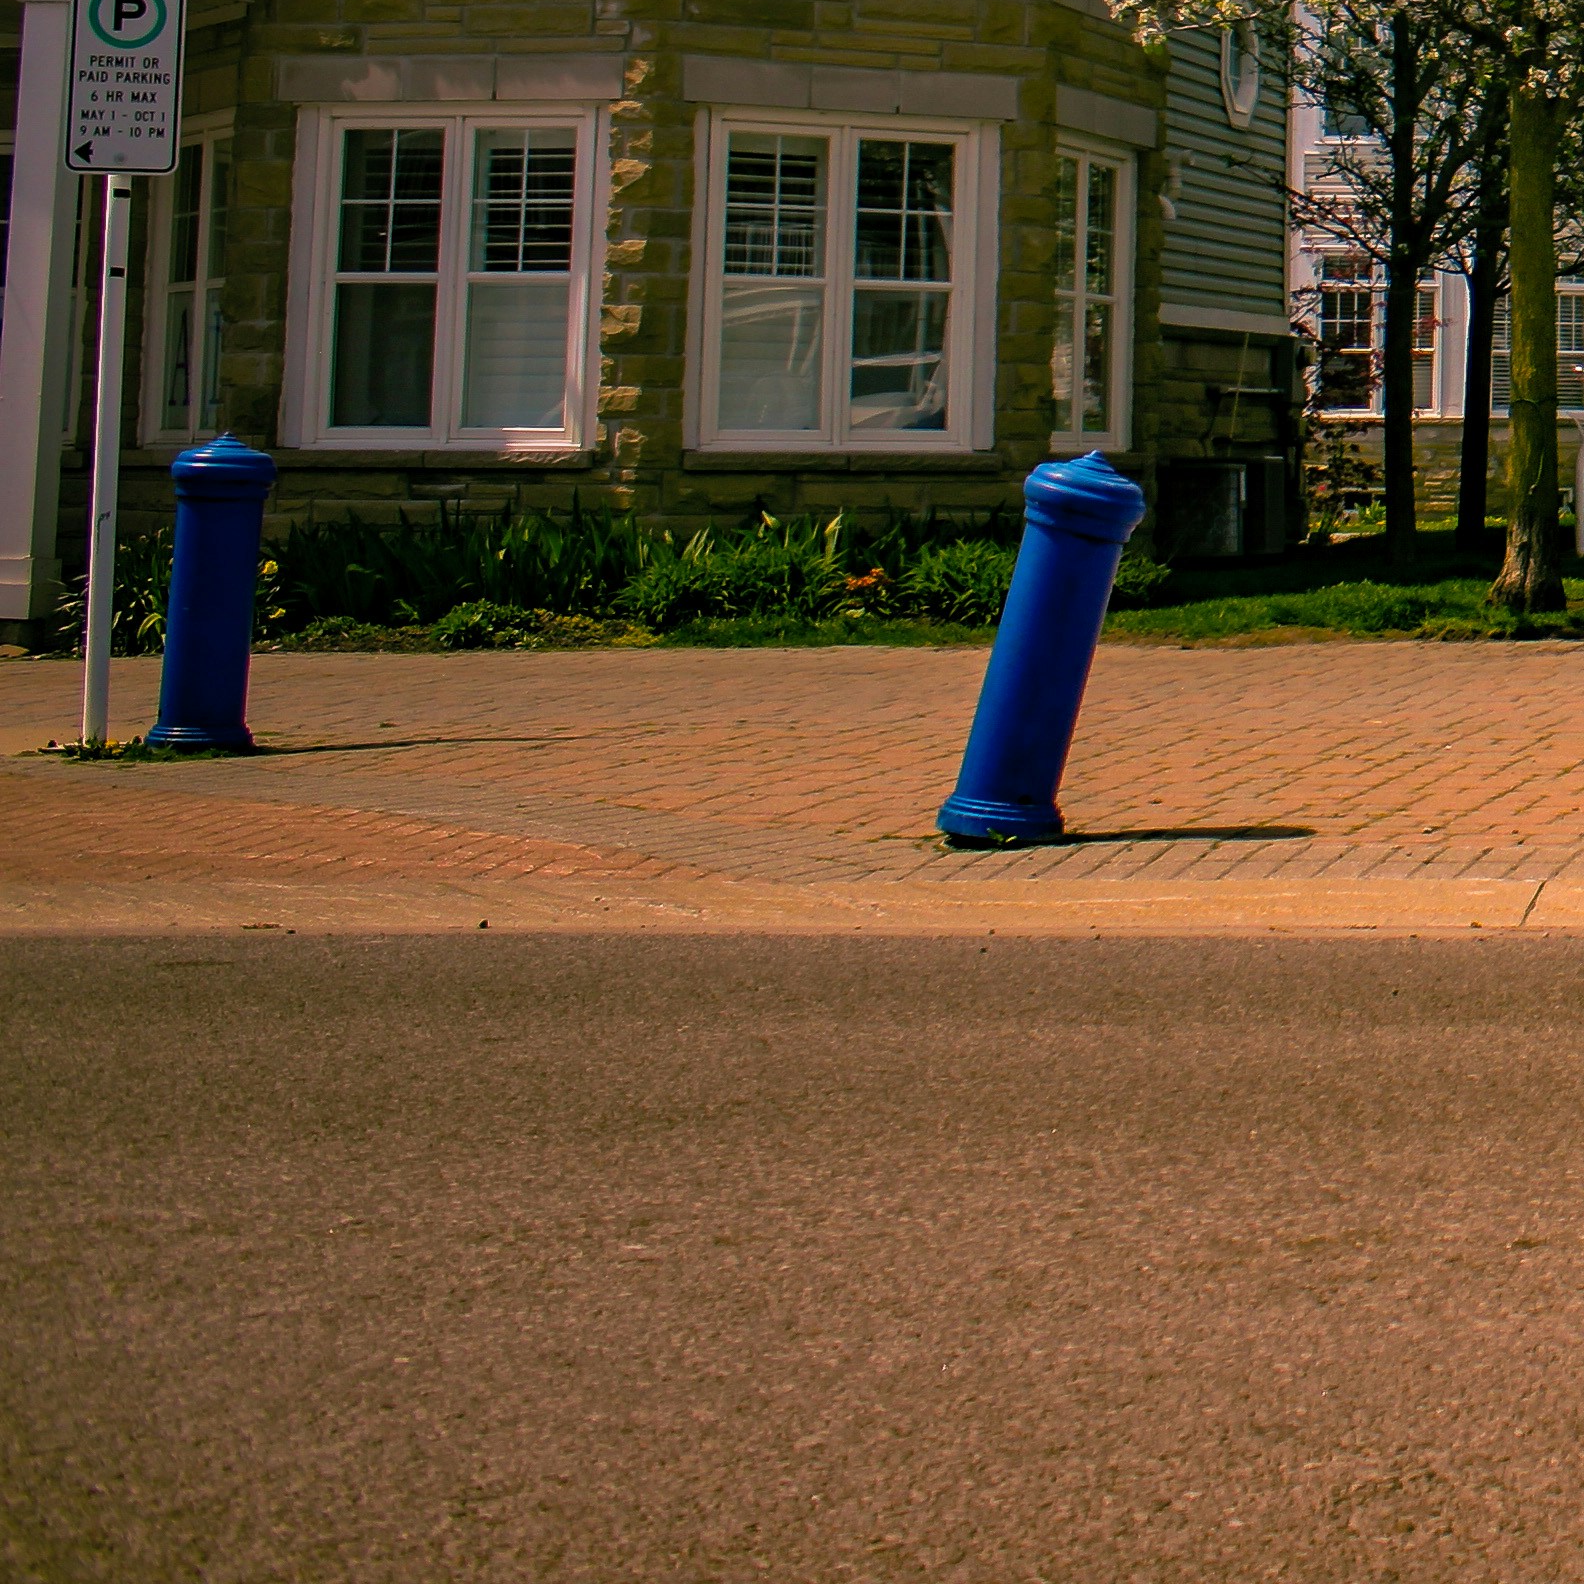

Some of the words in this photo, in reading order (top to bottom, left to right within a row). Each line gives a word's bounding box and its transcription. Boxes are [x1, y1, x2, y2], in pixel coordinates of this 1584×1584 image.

[90, 55, 136, 68] PERMIT
[143, 57, 160, 69] OR
[79, 70, 108, 83] PAID
[116, 72, 171, 85] PARKING
[91, 90, 99, 102] 6
[106, 91, 123, 102] HR
[131, 91, 158, 103] MAX
[81, 109, 105, 121] MAY
[111, 110, 115, 121] 1
[134, 111, 155, 122] OCT
[161, 112, 165, 122] 1
[80, 125, 87, 135] 9
[93, 126, 111, 136] AM
[130, 127, 142, 137] 10
[149, 127, 165, 138] PM
